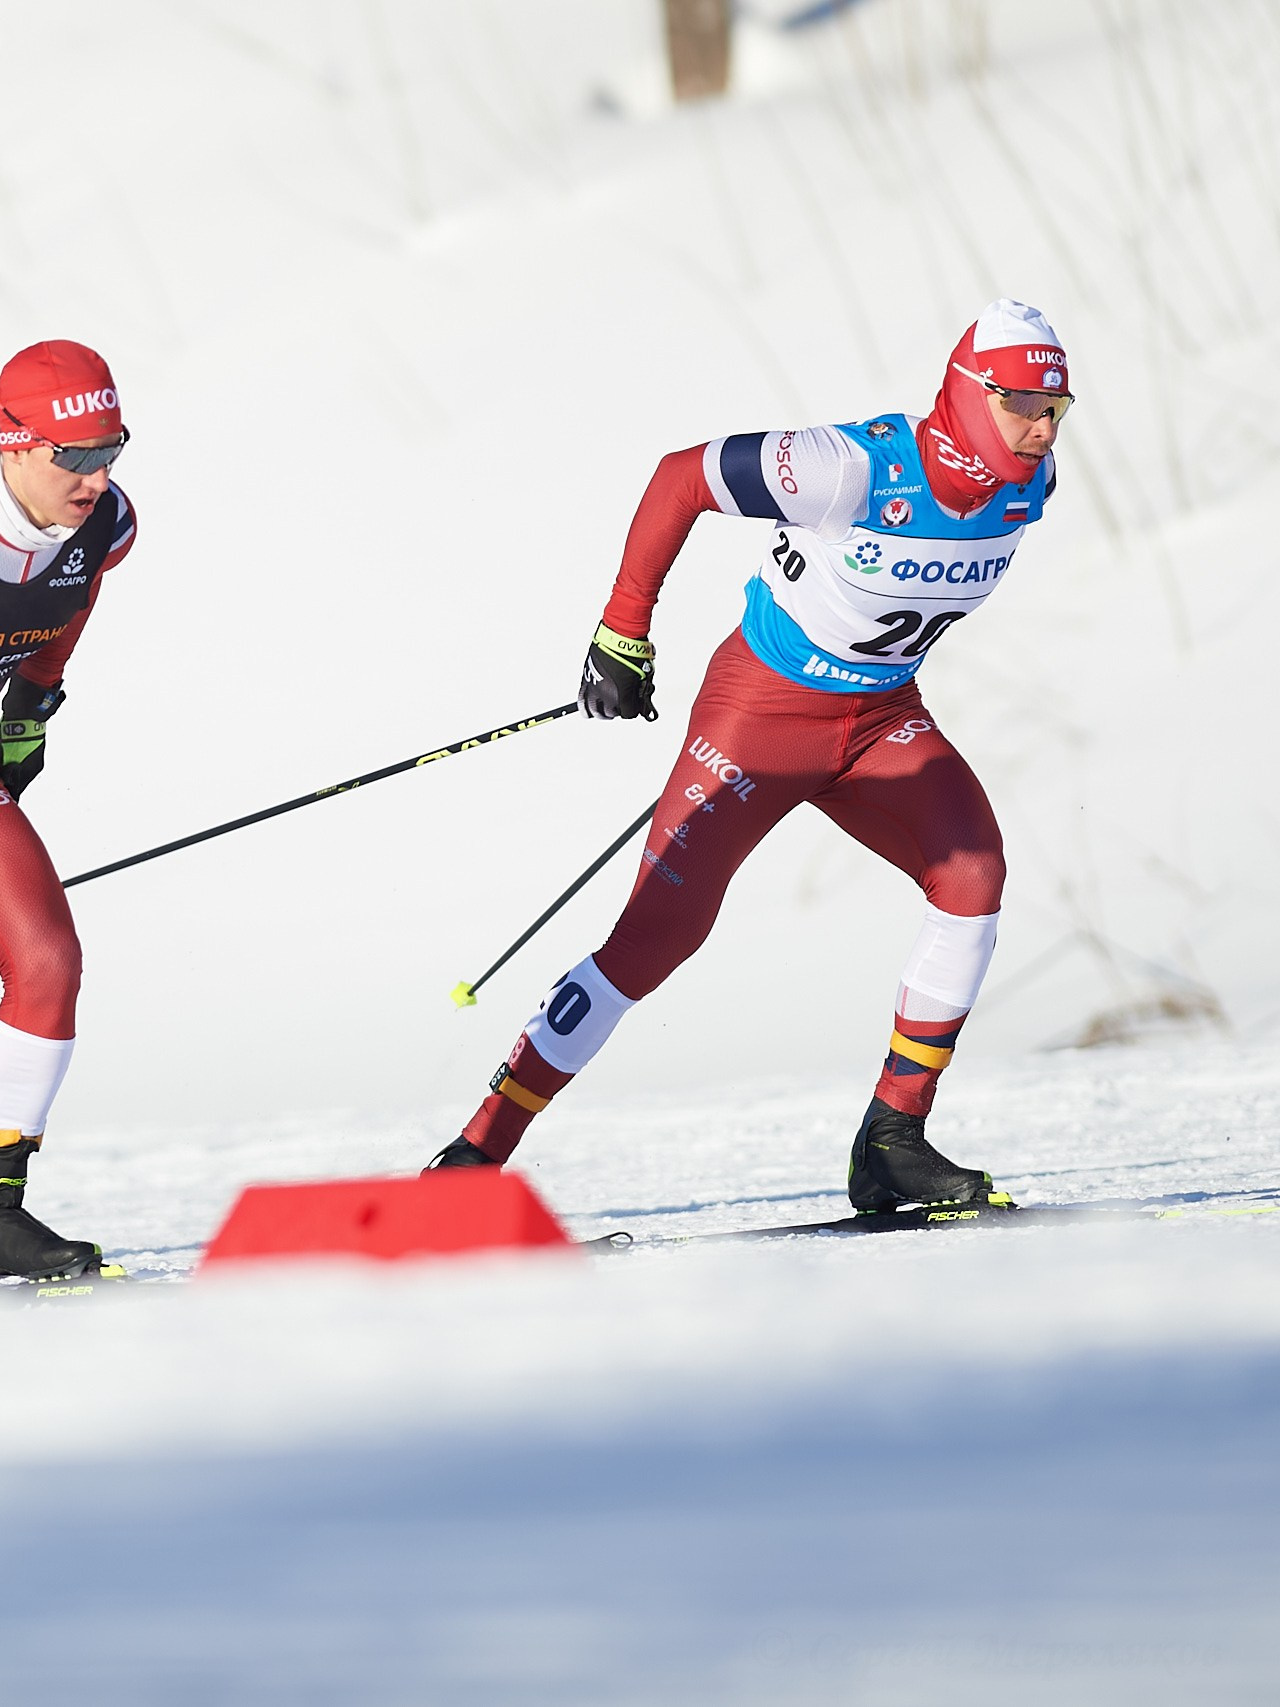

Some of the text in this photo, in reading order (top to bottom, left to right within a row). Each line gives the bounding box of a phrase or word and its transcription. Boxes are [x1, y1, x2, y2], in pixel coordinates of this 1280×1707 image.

[1027, 350, 1069, 369] LUKO
[52, 387, 120, 420] LUKO
[0, 431, 31, 445] OSCO
[873, 485, 923, 497] РУСКЛИМАТ
[772, 530, 807, 582] 20
[49, 576, 87, 587] ФОСАГРО
[849, 610, 967, 657] 20
[688, 736, 756, 802] LUKOIL
[927, 1210, 980, 1222] FISCHER
[36, 1285, 93, 1299] FISCHER
